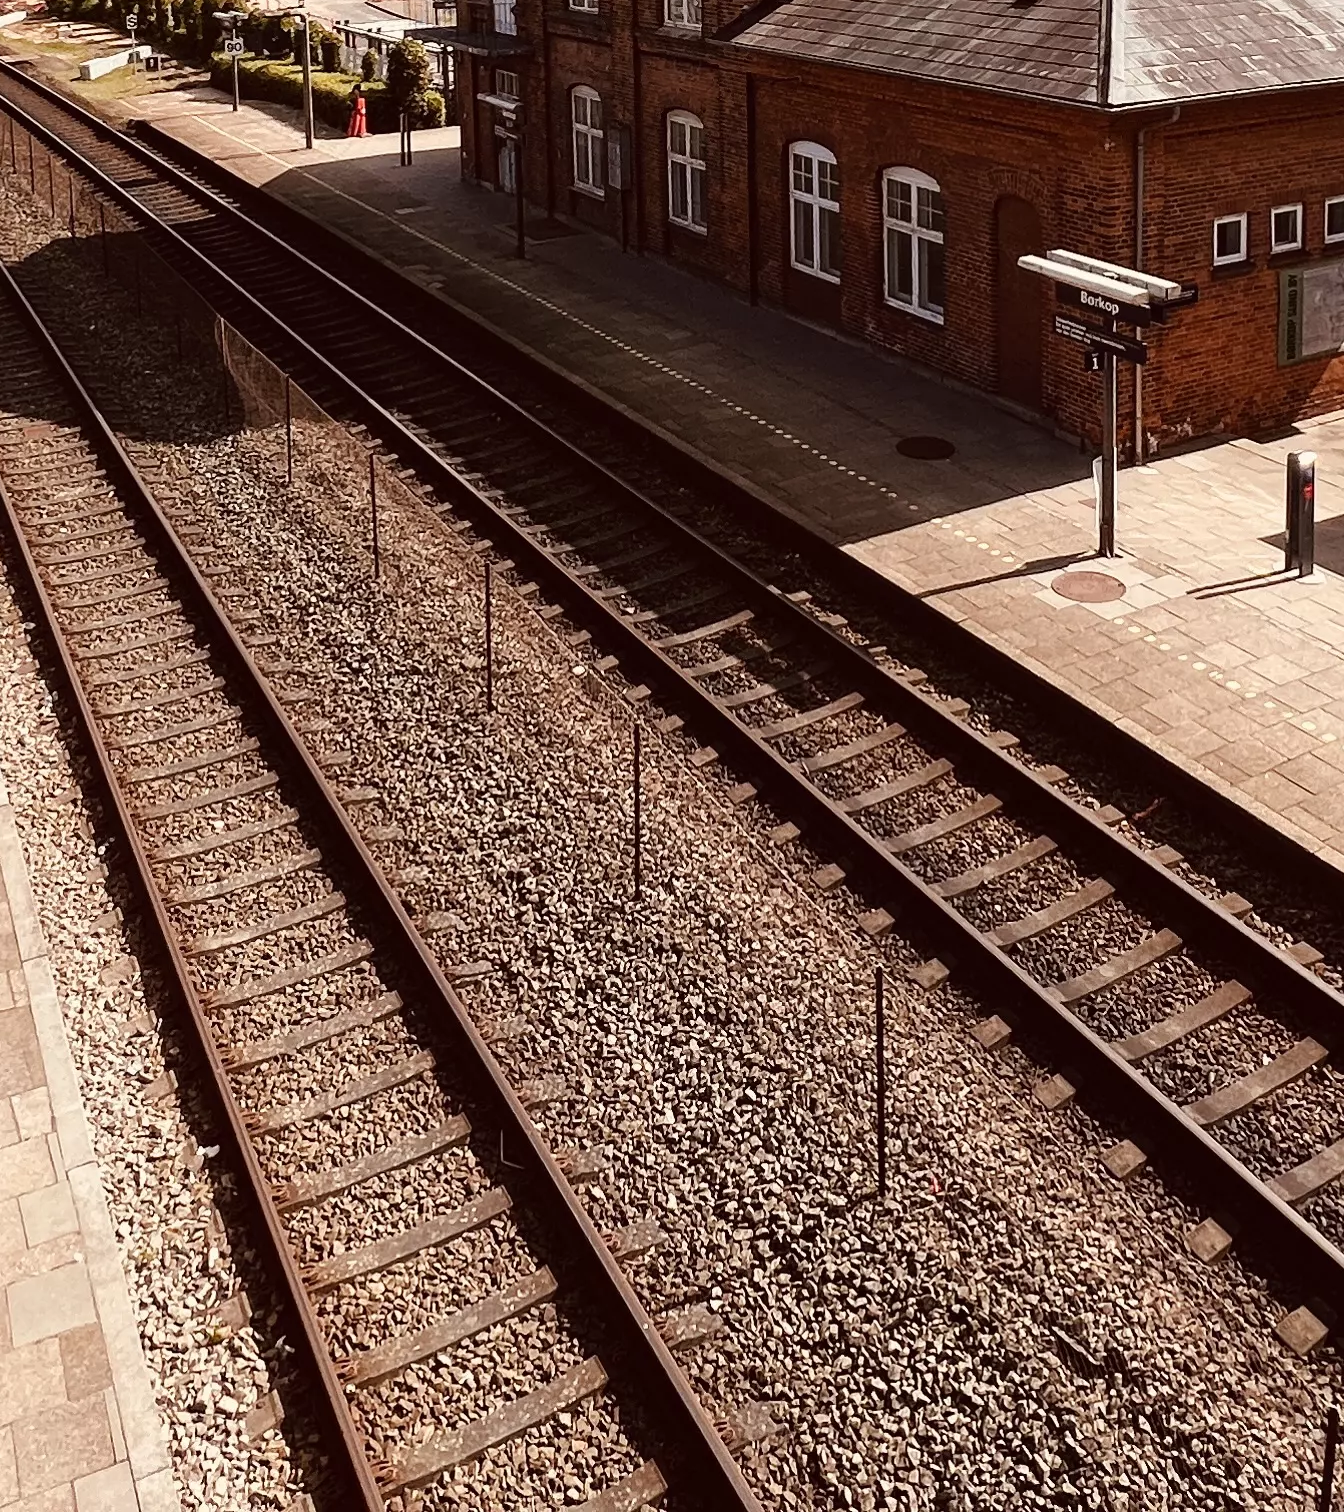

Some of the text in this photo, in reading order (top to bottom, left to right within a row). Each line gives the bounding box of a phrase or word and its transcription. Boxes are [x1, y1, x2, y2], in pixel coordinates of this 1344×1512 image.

[227, 42, 242, 52] 90
[1080, 290, 1120, 316] Børkop
[1092, 357, 1099, 369] 1
